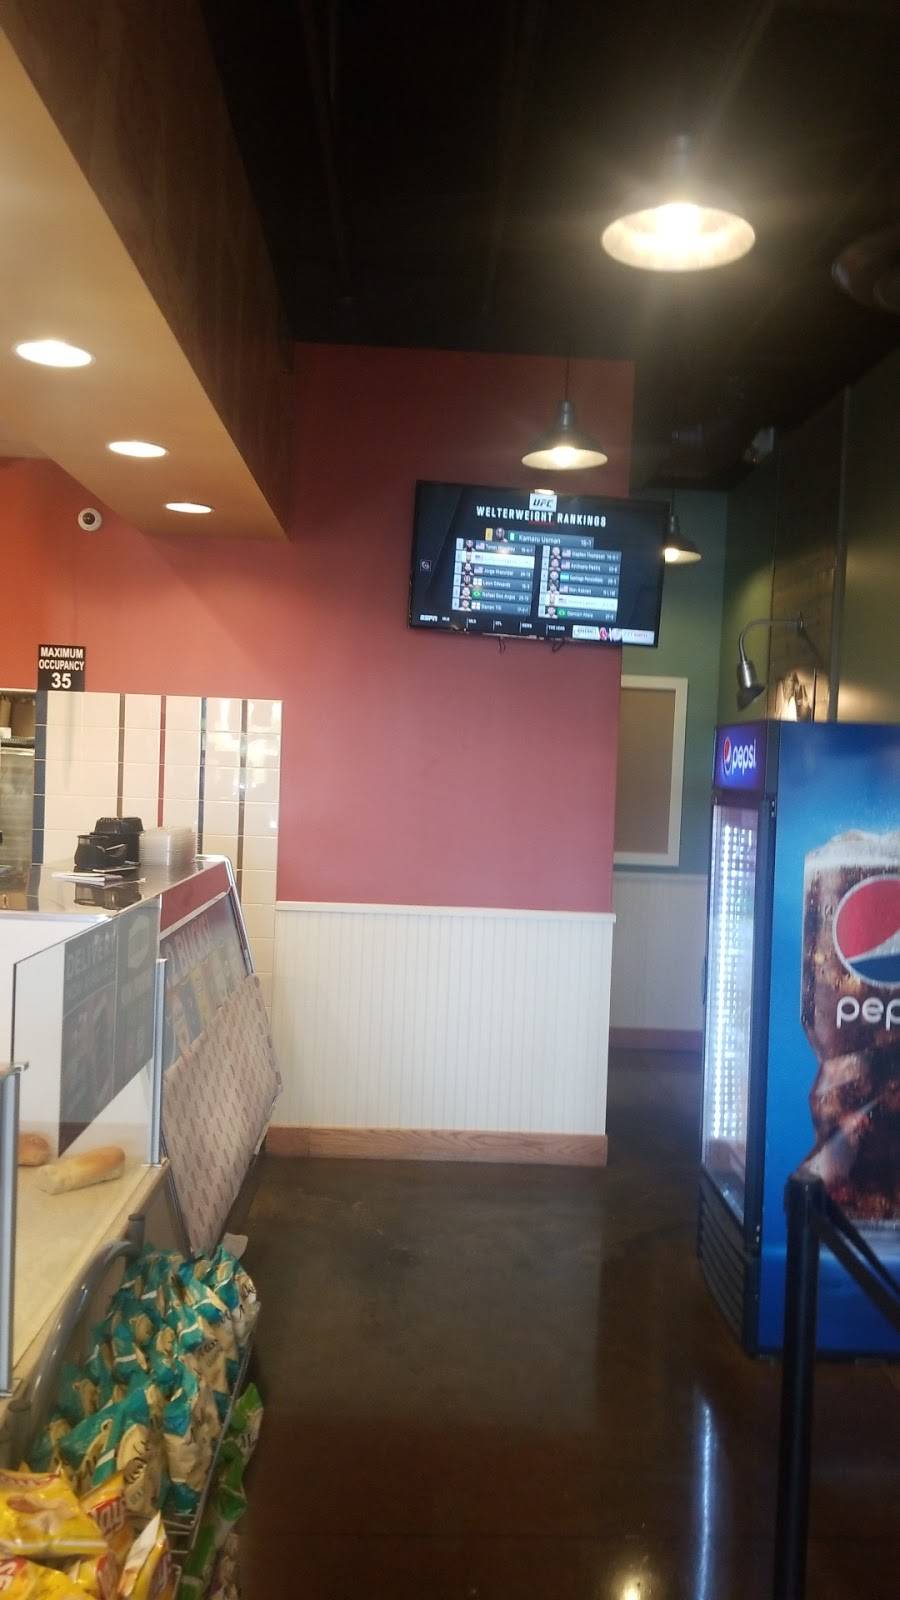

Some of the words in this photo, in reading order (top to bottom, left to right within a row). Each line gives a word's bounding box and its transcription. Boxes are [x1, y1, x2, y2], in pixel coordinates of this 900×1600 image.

[532, 498, 552, 509] UFC
[476, 505, 554, 522] WELTERWEIGHT
[557, 512, 607, 528] RANKINGS
[40, 646, 84, 659] MAXIMUM
[38, 659, 85, 671] OCCUPANCY
[51, 672, 72, 689] 35
[732, 737, 757, 776] pepsi
